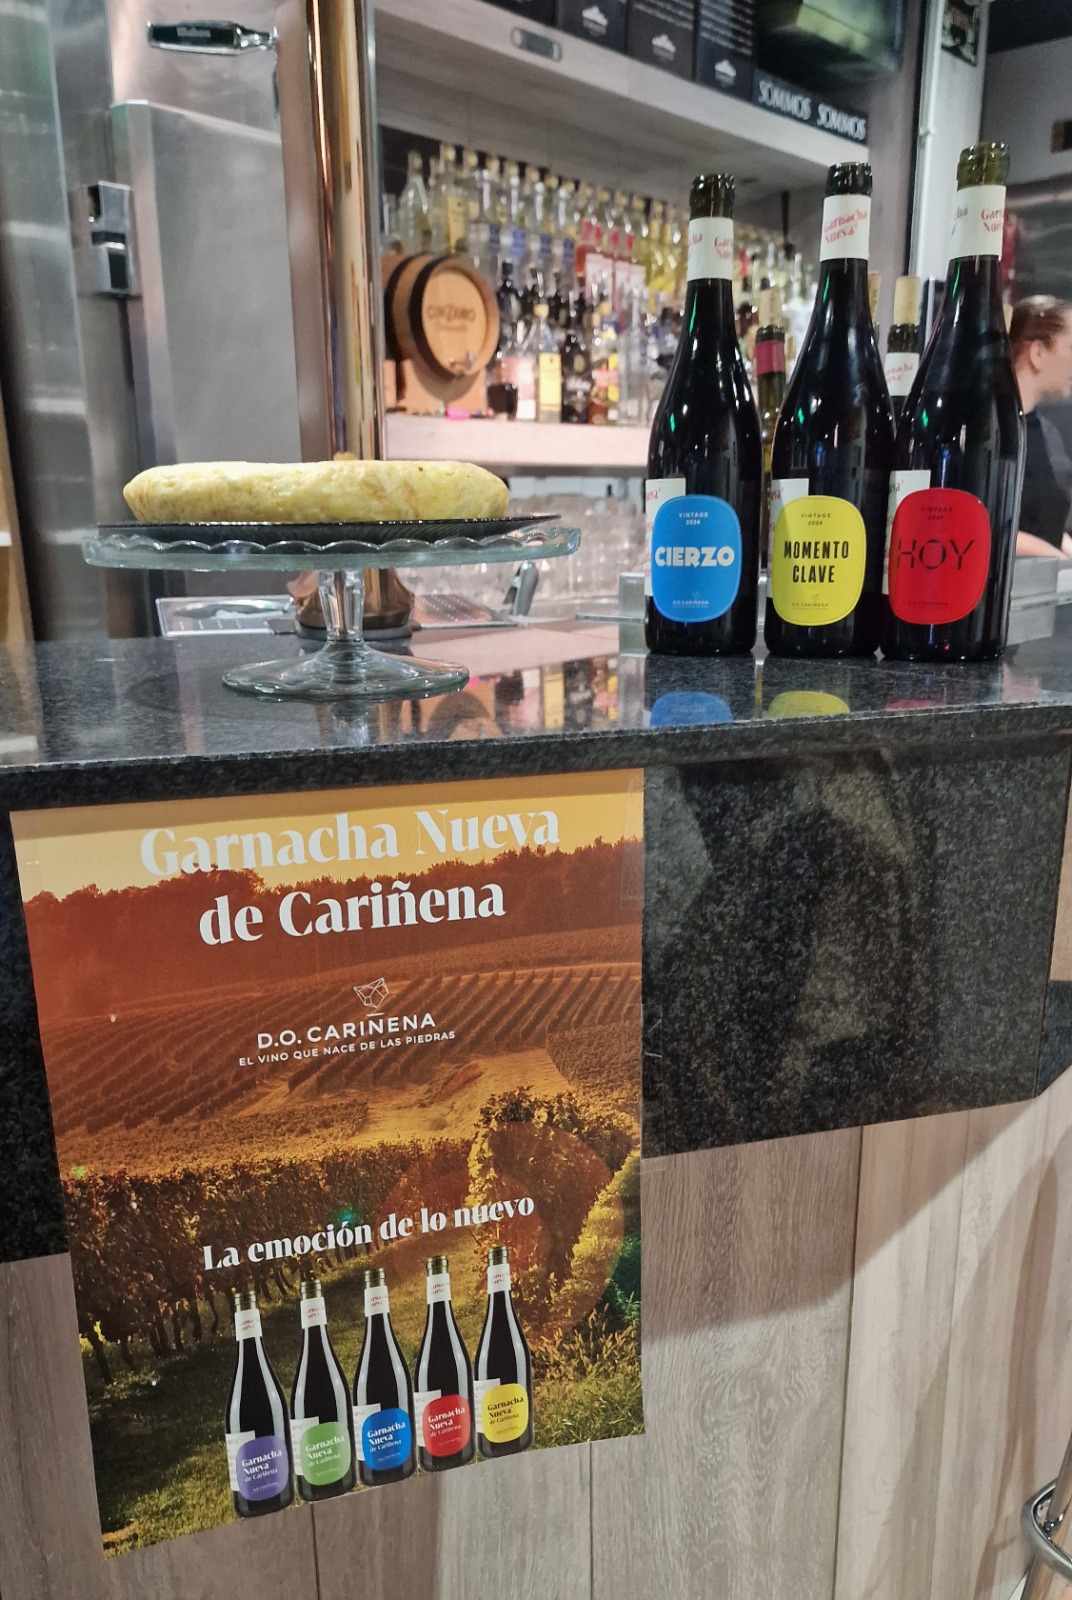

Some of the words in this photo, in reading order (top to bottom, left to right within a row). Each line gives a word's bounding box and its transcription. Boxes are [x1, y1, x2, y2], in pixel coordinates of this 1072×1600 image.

[654, 545, 735, 568] CIERZO
[783, 540, 849, 560] MOMENTO
[897, 538, 975, 570] HOY
[792, 565, 836, 584] CLAVE
[140, 813, 400, 877] Garnacha
[415, 809, 561, 856] Nueva
[199, 895, 264, 946] de
[278, 880, 506, 938] Cariñena
[257, 1030, 302, 1049] D.O.
[307, 1012, 436, 1043] CARIÑENA
[239, 1057, 254, 1067] EL
[258, 1052, 289, 1064] VINO
[293, 1048, 319, 1060] QUE
[323, 1044, 355, 1055] NACE
[360, 1041, 376, 1051] DE
[380, 1037, 402, 1048] LAS
[405, 1031, 455, 1044] PIEDRAS
[203, 1245, 240, 1271] La
[247, 1221, 372, 1263] emoción
[380, 1212, 415, 1241] de
[421, 1206, 447, 1234] lo
[453, 1197, 535, 1228] nuevo
[487, 1397, 524, 1411] Garnacha
[489, 1408, 512, 1418] Nueva
[428, 1406, 465, 1423] Garnacha
[367, 1422, 406, 1438] Garnacha
[430, 1419, 454, 1431] Nueva
[305, 1435, 345, 1453] Garnacha
[369, 1433, 394, 1446] Nueva
[241, 1450, 283, 1467] Garnacha
[307, 1447, 333, 1460] Nueva
[244, 1463, 270, 1475] Nueva
